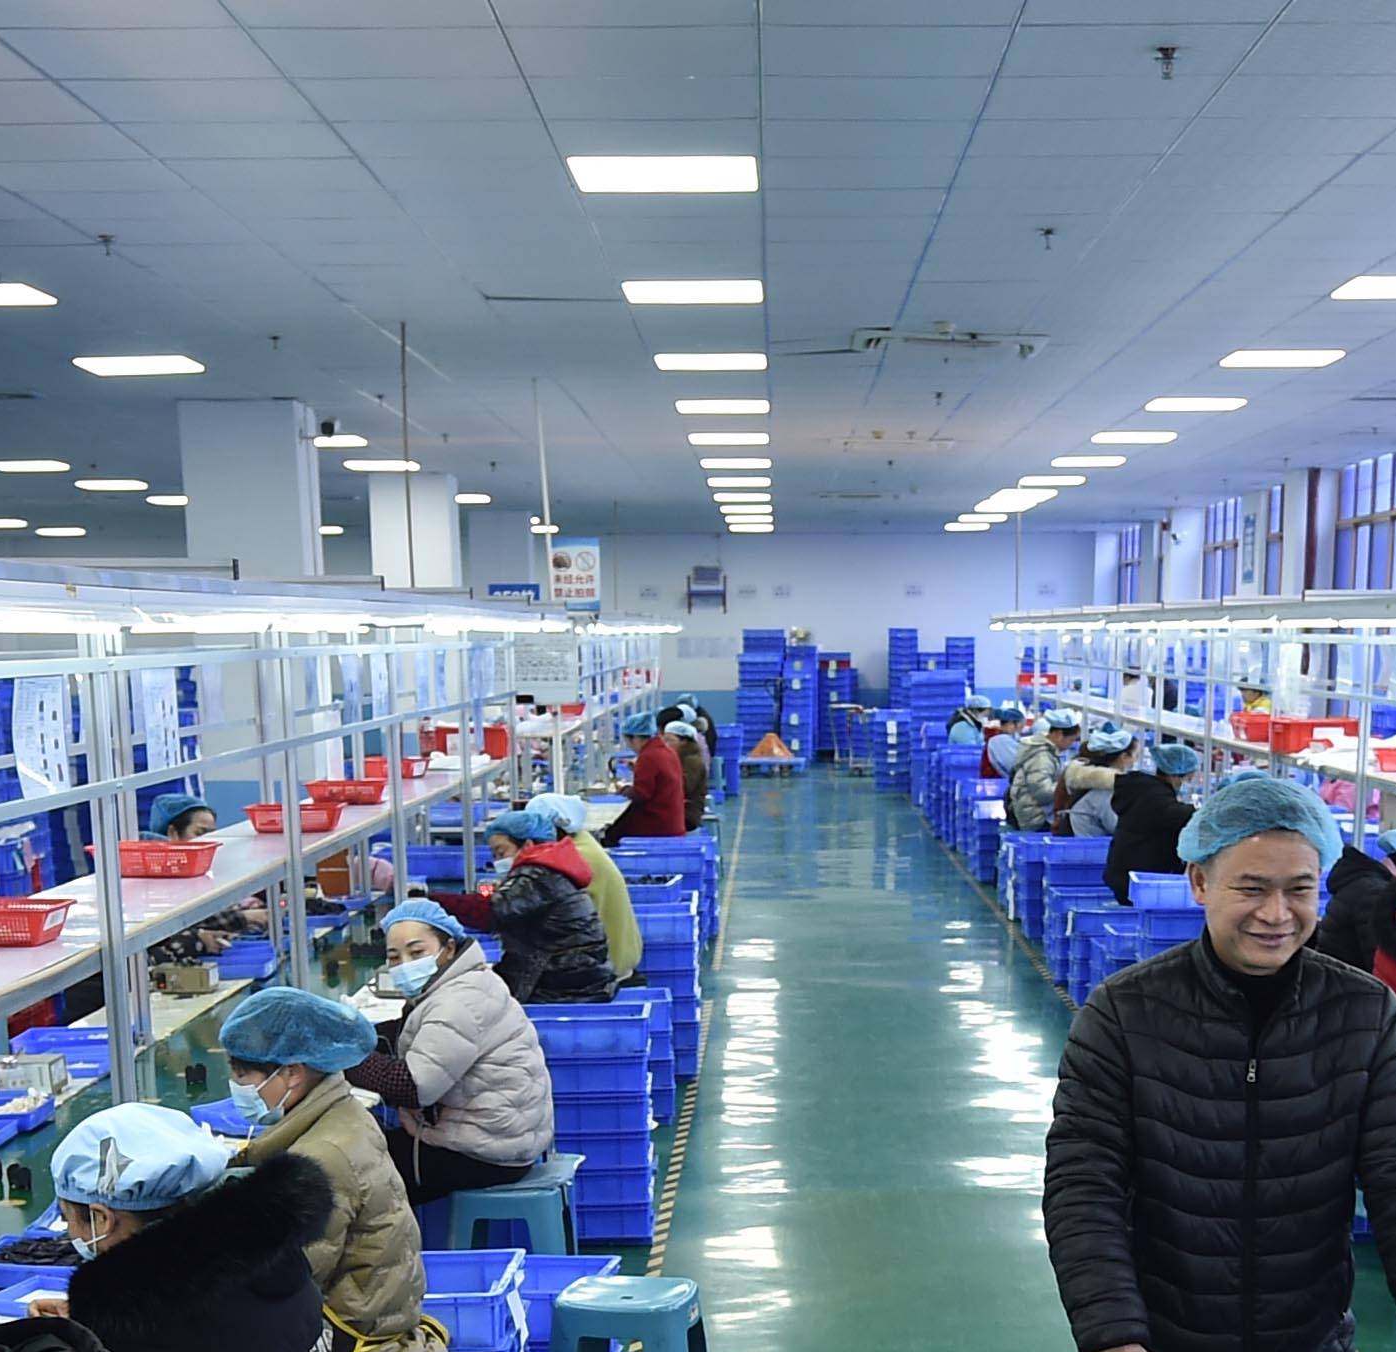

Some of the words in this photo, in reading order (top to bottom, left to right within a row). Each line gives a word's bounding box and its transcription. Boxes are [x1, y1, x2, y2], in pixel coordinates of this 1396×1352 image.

[554, 573, 595, 585] 未经允许
[554, 587, 596, 598] 禁止拍照
